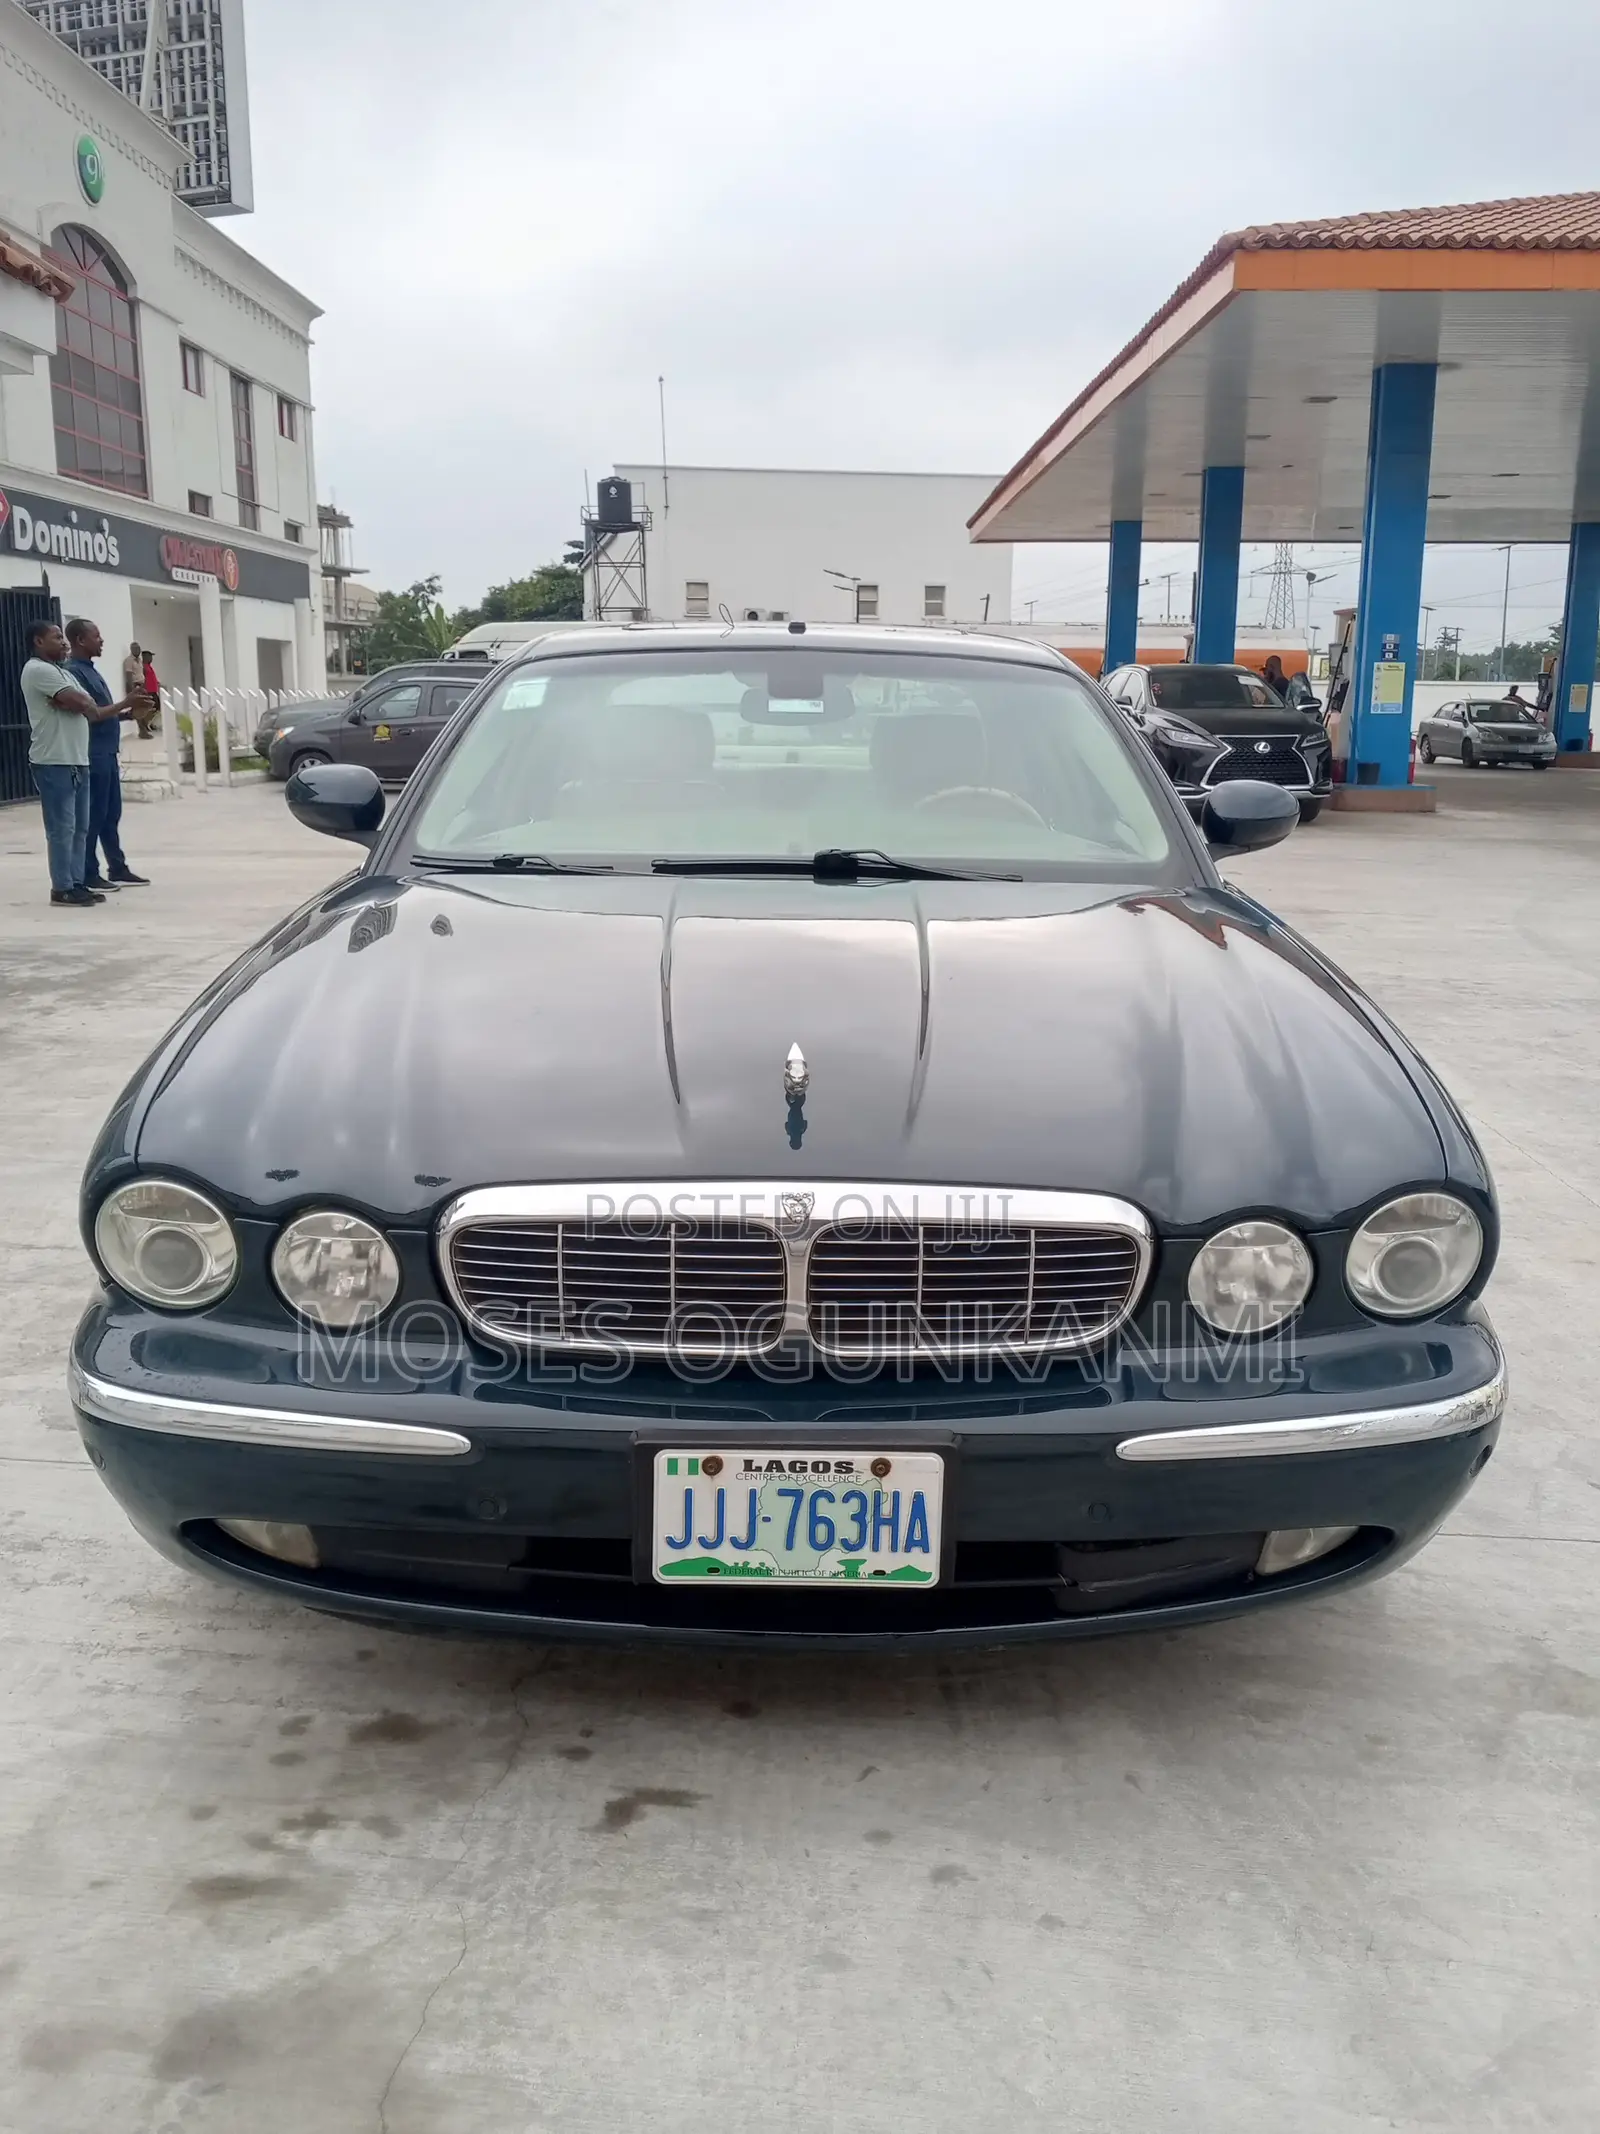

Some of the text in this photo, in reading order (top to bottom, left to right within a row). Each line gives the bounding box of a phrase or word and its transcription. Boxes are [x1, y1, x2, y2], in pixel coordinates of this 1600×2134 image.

[12, 504, 119, 566] Domino's
[735, 1472, 862, 1483] CENTRE OF EXCELLENCE
[743, 1459, 854, 1474] LAGOS
[665, 1486, 931, 1554] JJJ-763HA
